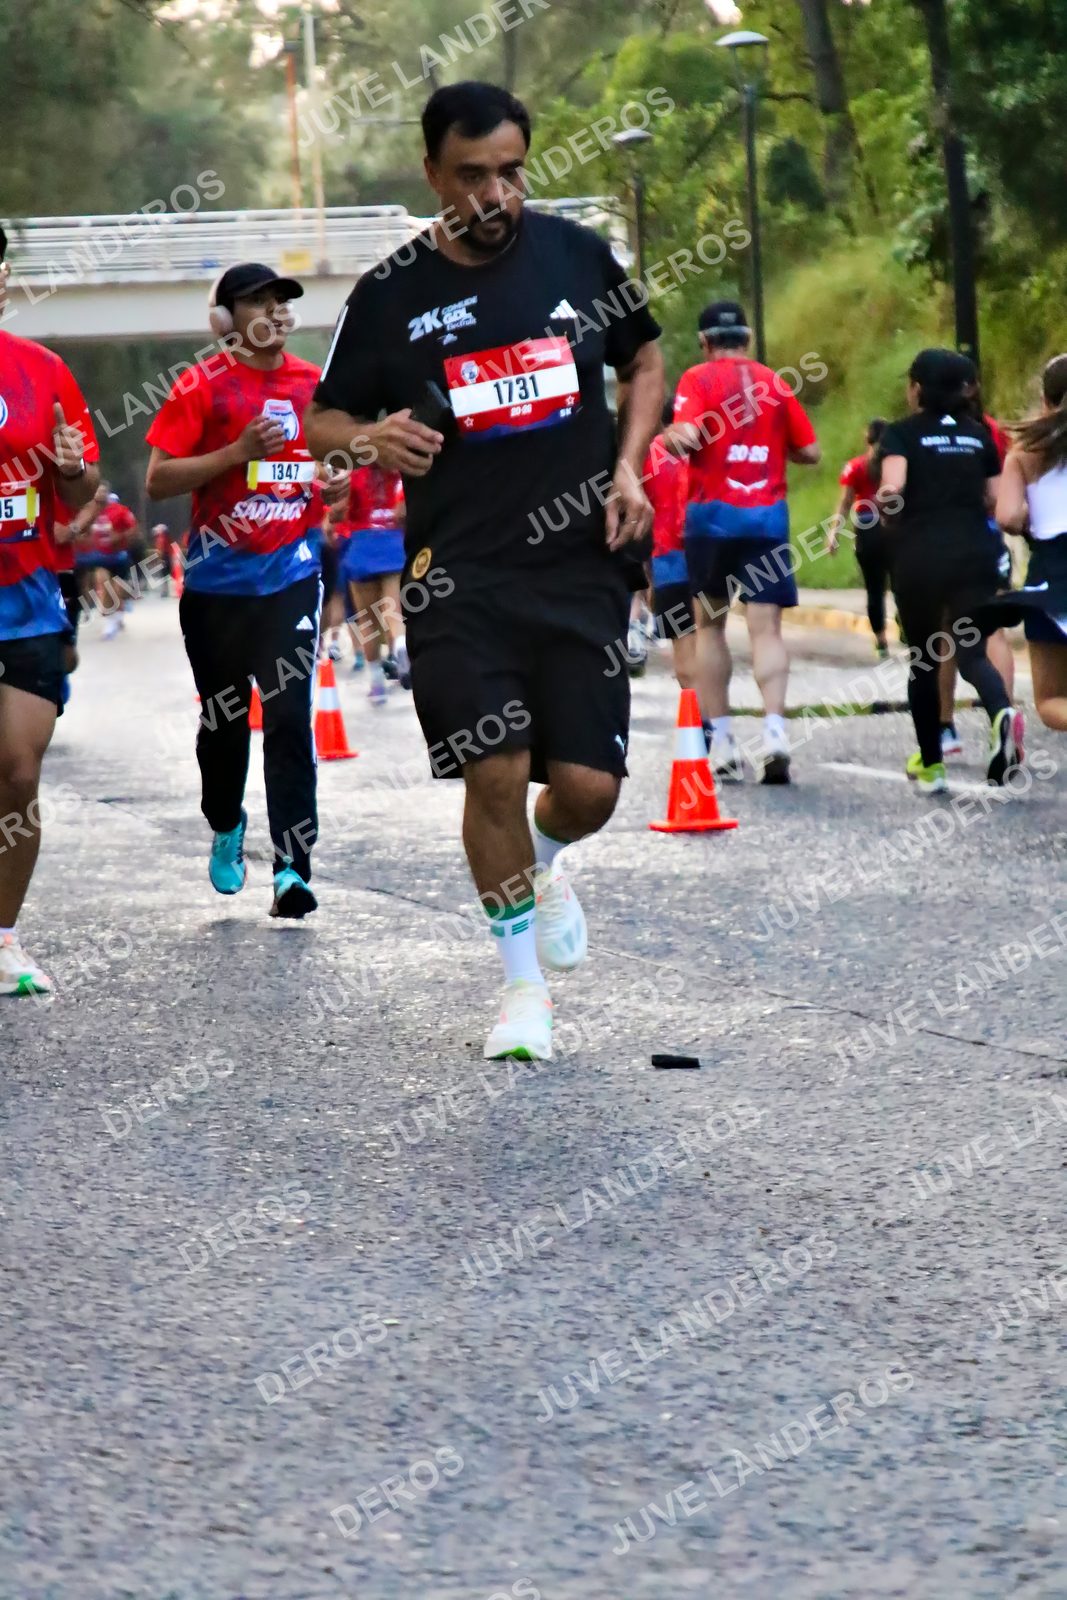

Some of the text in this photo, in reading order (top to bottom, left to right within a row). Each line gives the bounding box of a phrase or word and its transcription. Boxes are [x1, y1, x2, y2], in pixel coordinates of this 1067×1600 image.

[493, 374, 540, 405] 1731
[272, 464, 299, 480] 1347
[0, 499, 14, 519] 5
